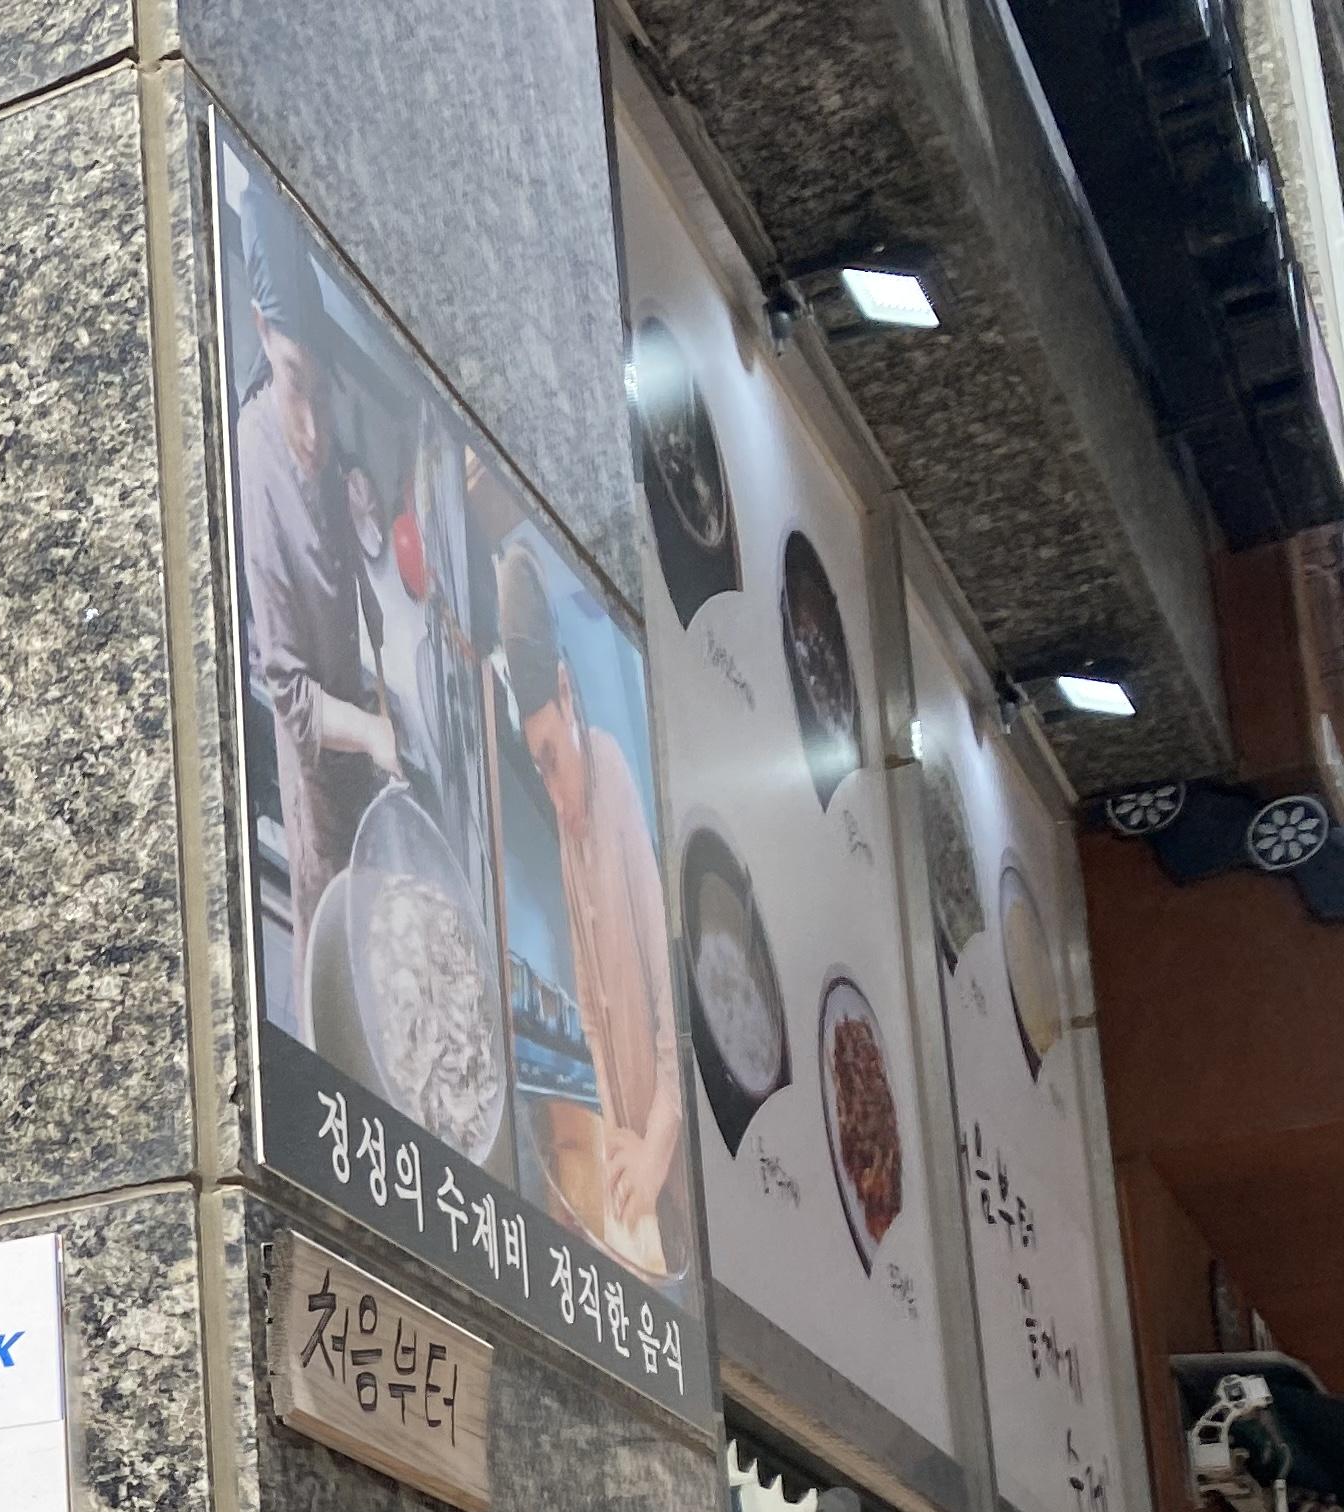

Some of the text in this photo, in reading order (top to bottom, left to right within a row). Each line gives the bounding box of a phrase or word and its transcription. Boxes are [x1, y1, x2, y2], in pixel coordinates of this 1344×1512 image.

[299, 1268, 459, 1448] 처음부터
[318, 1090, 685, 1396] 정성의 수제비 정직한 음식
